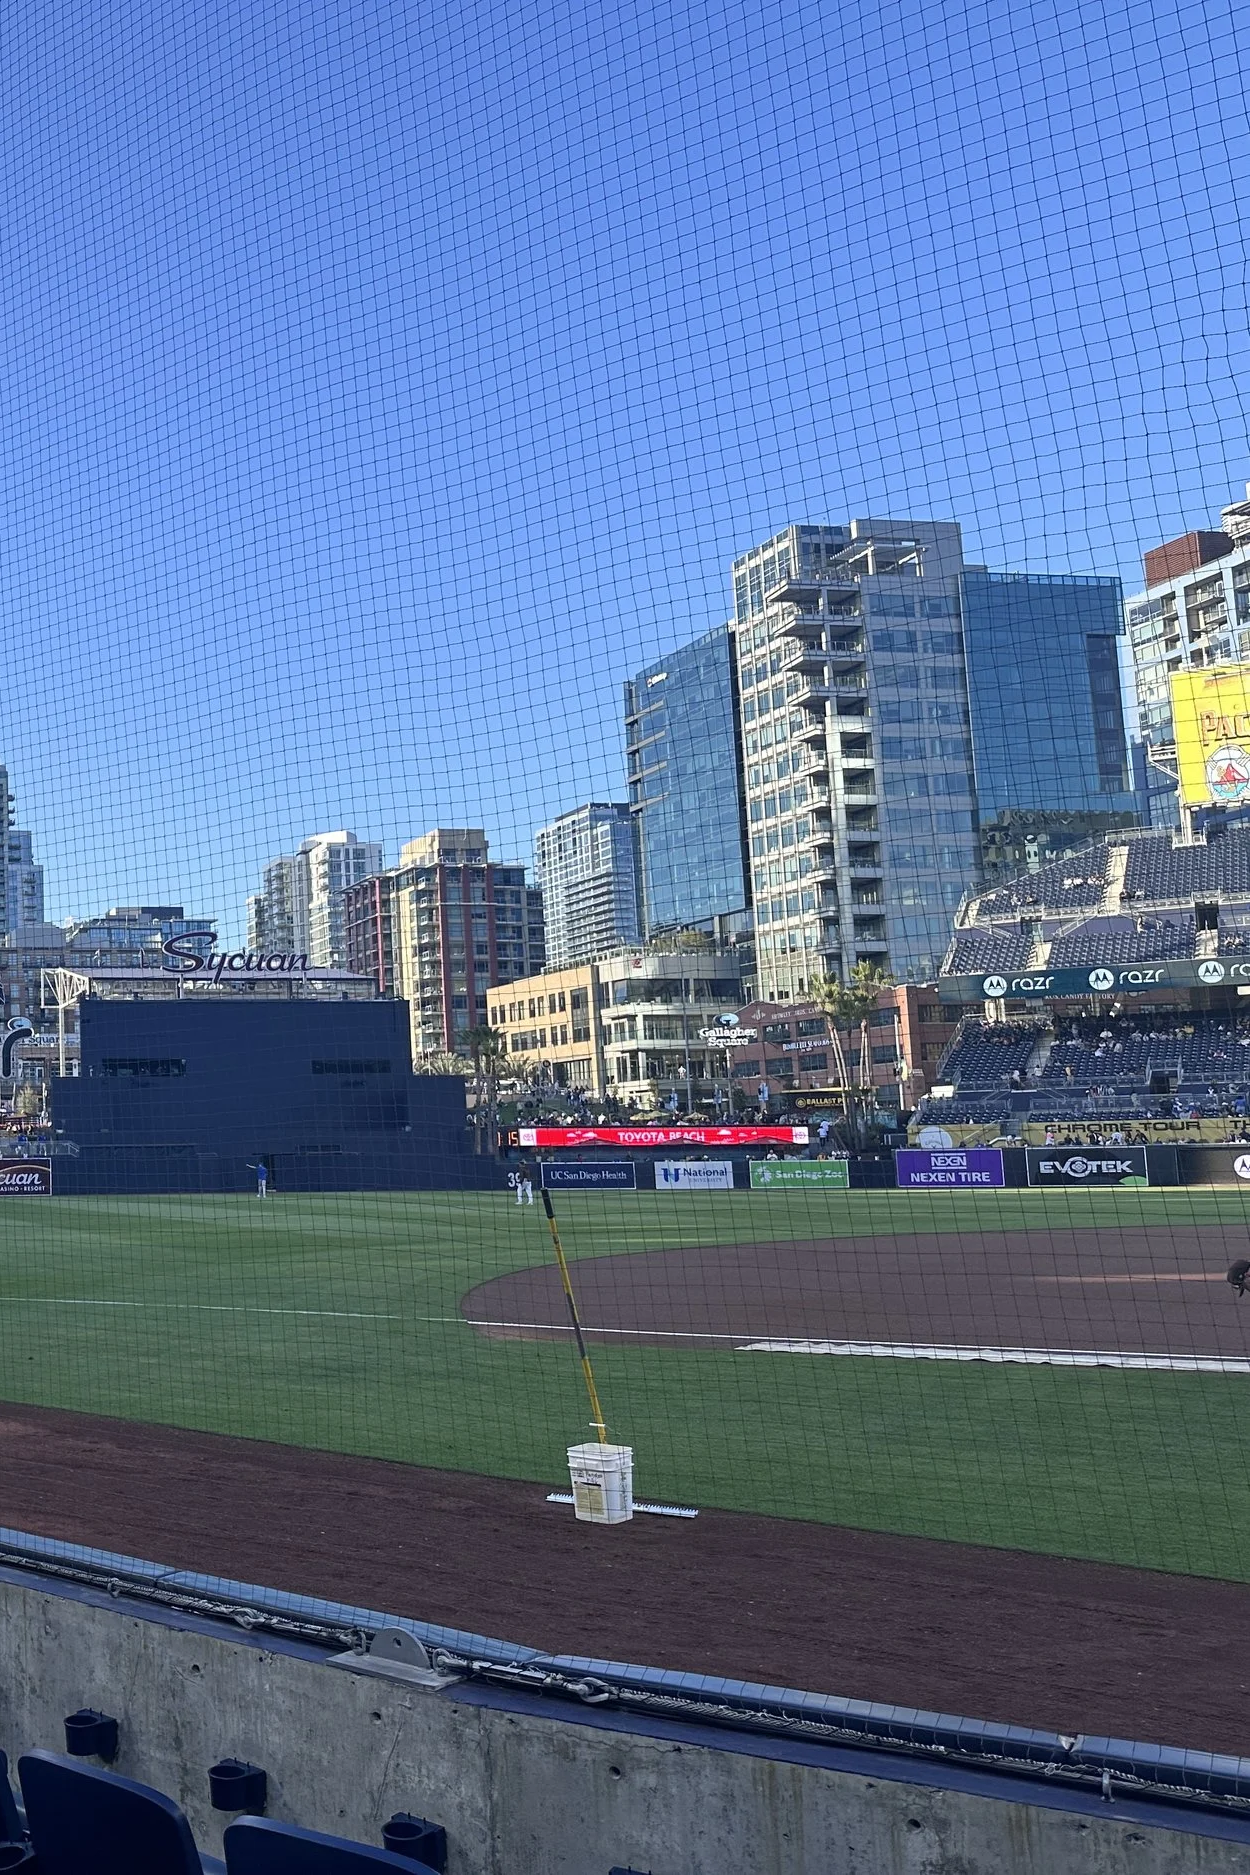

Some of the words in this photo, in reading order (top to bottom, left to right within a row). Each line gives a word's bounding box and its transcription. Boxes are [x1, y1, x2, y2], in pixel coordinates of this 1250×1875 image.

[160, 931, 313, 984] Sycuan
[1119, 968, 1165, 985] razr
[1011, 976, 1055, 992] razr
[1085, 992, 1116, 1000] FATORY
[699, 1026, 758, 1040] Gallagher
[707, 1036, 749, 1049] Square
[806, 1097, 837, 1106] BALLAST
[1044, 1121, 1133, 1135] CHROME
[1138, 1120, 1201, 1131] TOUR
[617, 1131, 664, 1143] TOYOTA
[668, 1131, 706, 1142] BEACH
[683, 1167, 727, 1177] National
[1038, 1156, 1134, 1178] EVOTEK
[550, 1170, 564, 1180] UC
[564, 1170, 579, 1180] San
[579, 1170, 600, 1181] Diego
[601, 1170, 627, 1180] Health
[774, 1169, 793, 1179] San
[794, 1169, 822, 1180] Diego
[824, 1169, 845, 1179] Zoo
[910, 1172, 955, 1183] NEXEN
[958, 1171, 991, 1182] TIRE
